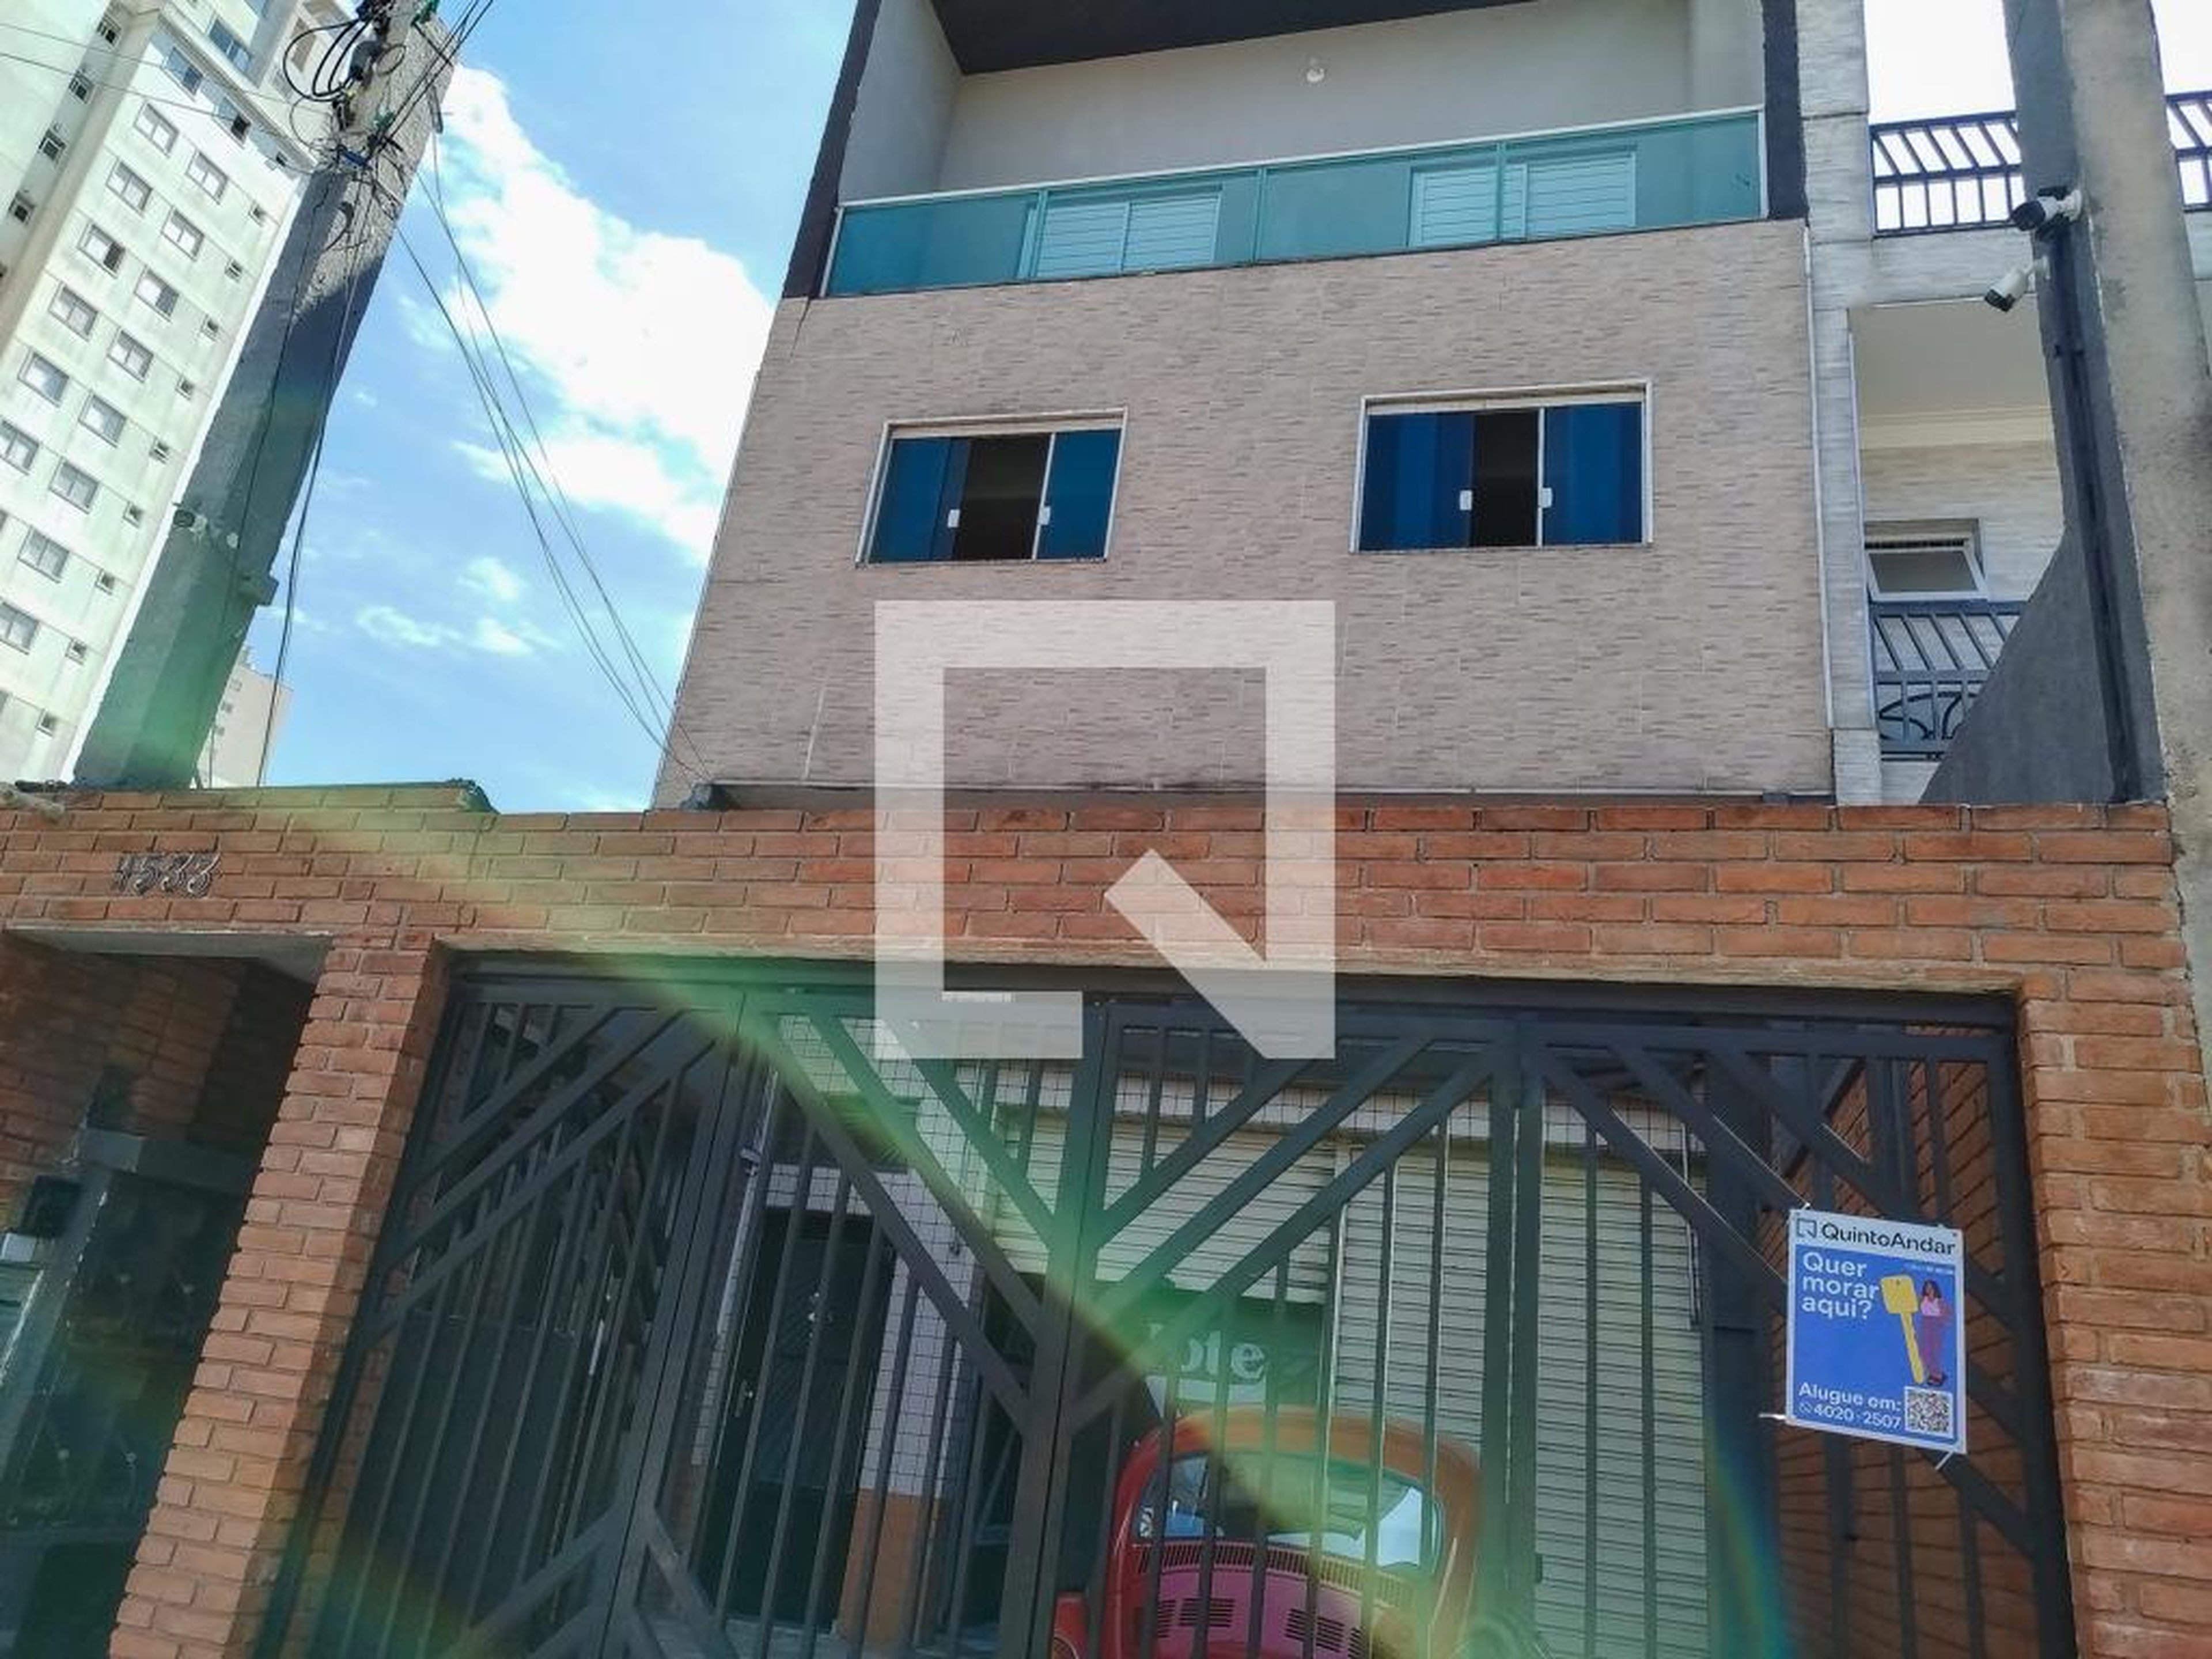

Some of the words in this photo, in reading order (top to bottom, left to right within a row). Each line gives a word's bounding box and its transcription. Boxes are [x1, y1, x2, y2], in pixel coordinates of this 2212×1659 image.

[1821, 1222, 1956, 1255] QuintoAndar
[1802, 1252, 1868, 1277] Quer
[1802, 1275, 1879, 1300] morar
[1801, 1296, 1872, 1320] aqui?
[1798, 1382, 1863, 1406] Alugue
[1867, 1396, 1902, 1412] em:
